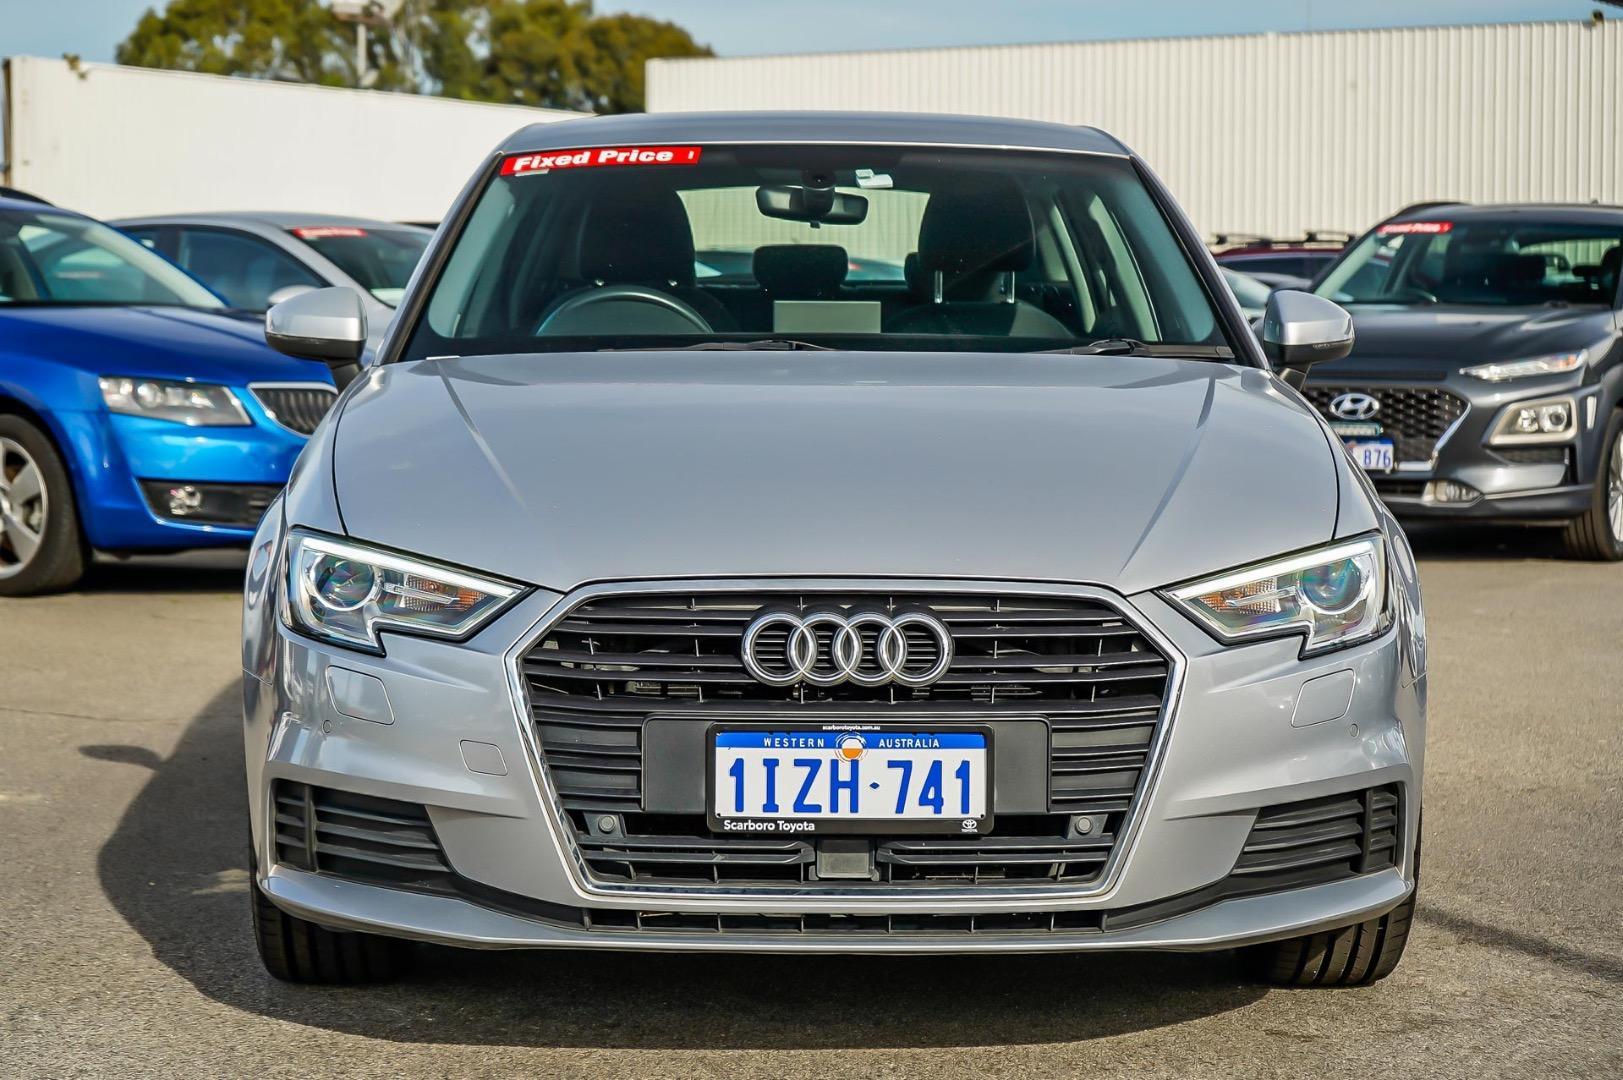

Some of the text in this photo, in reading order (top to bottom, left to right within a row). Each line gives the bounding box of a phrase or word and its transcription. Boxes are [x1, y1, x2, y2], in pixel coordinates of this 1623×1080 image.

[512, 149, 674, 171] Fixed Price
[763, 737, 940, 748] WESTERN AUSTRALIA
[723, 819, 815, 833] Scarboro Toyota
